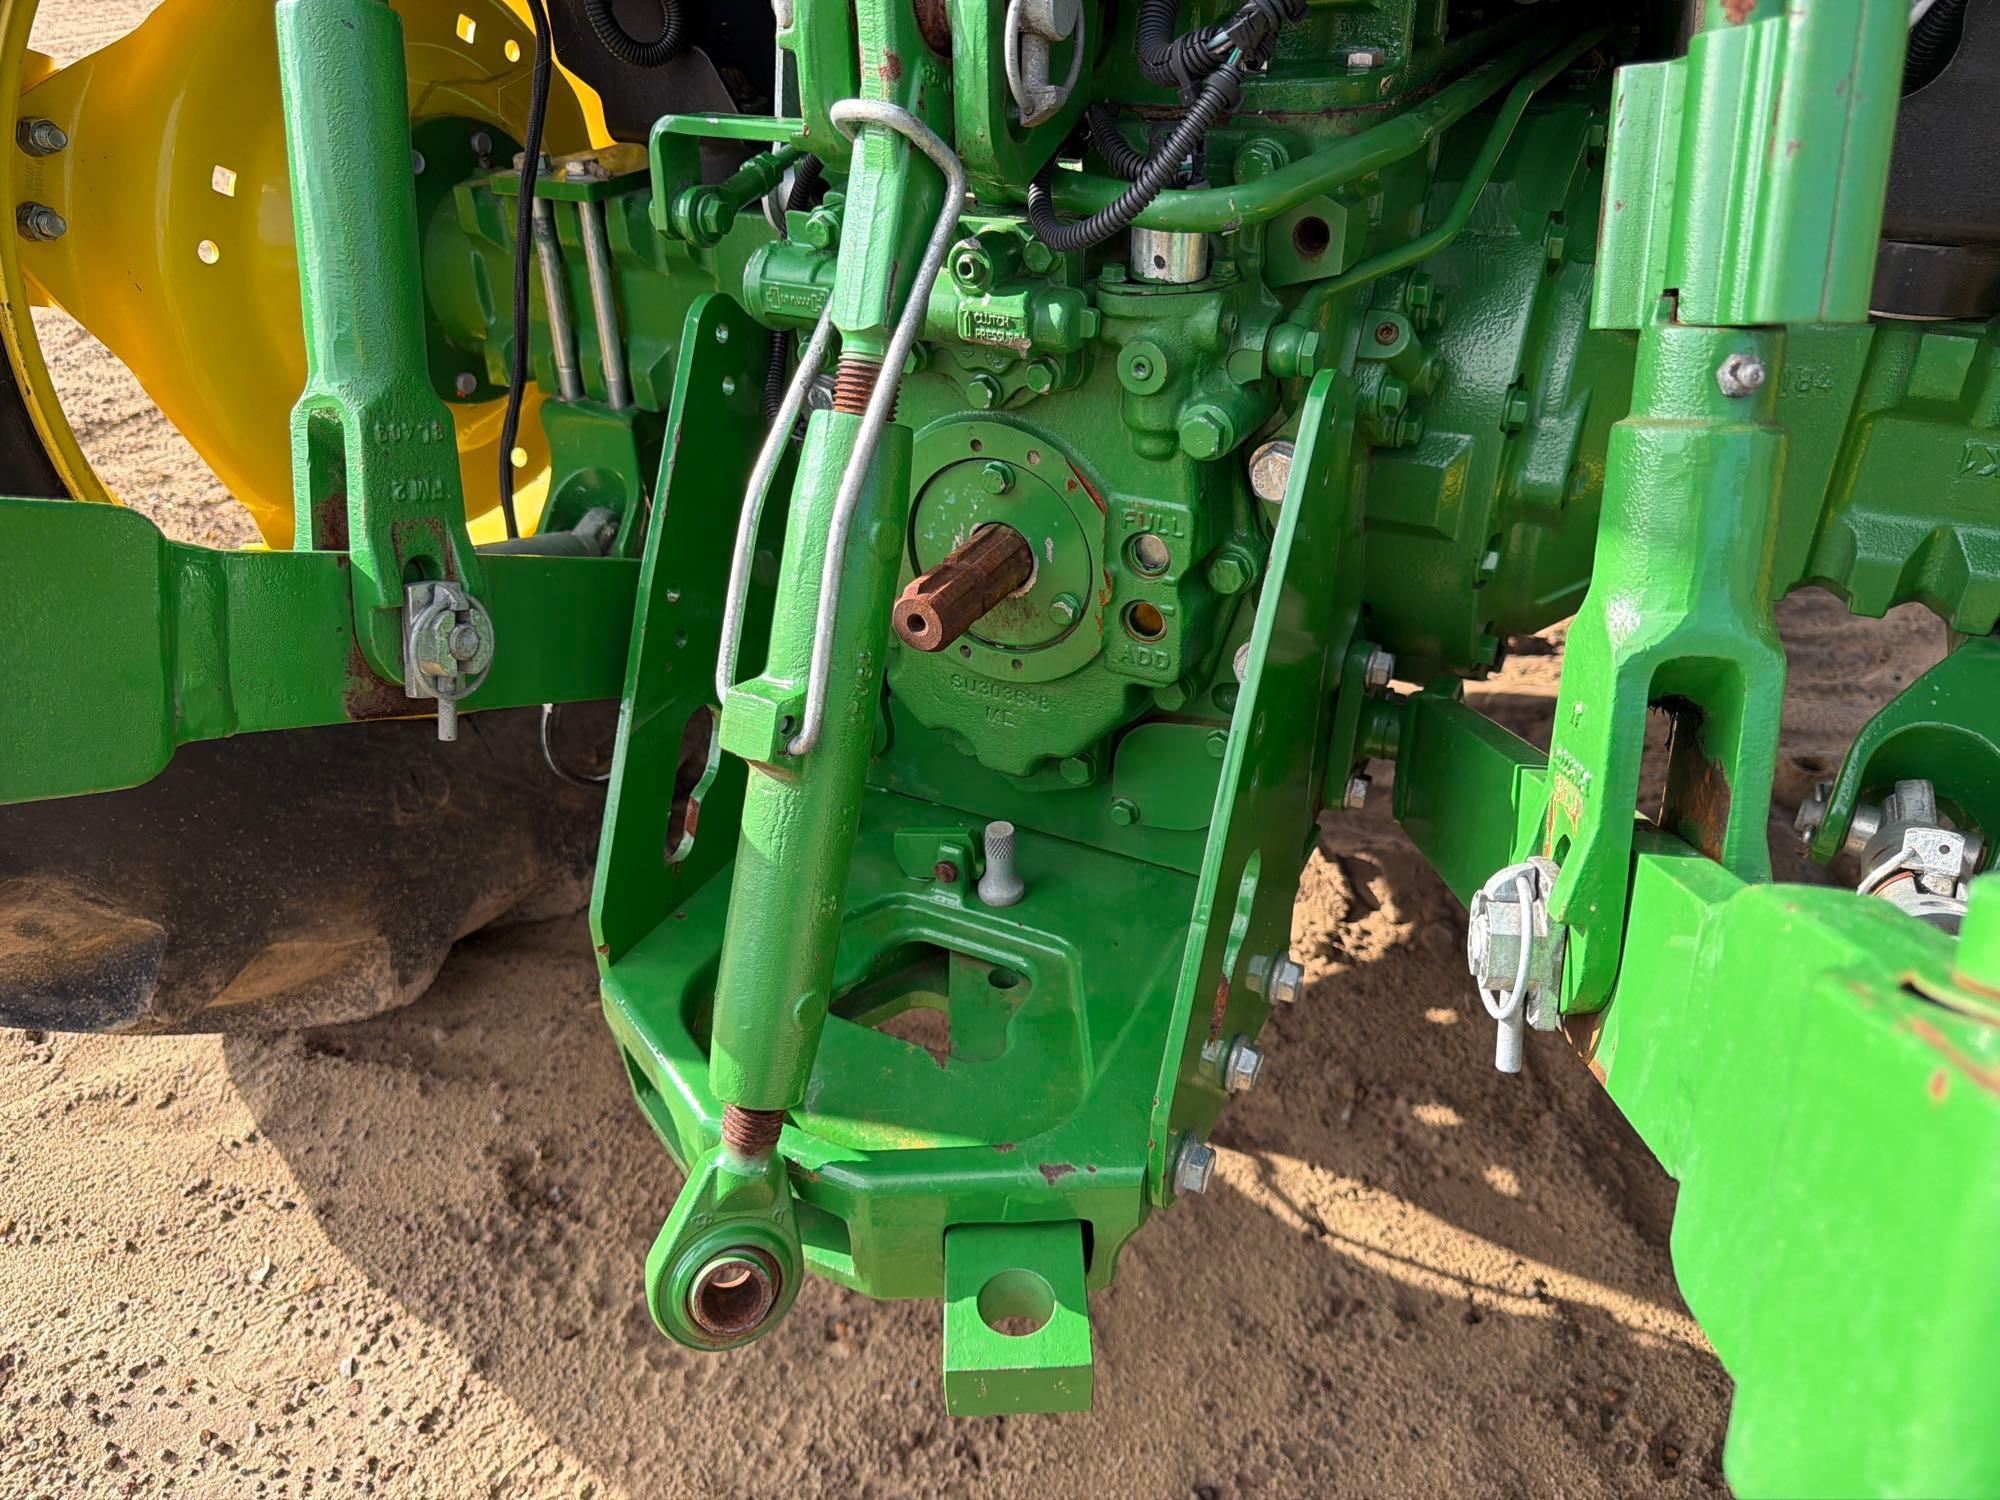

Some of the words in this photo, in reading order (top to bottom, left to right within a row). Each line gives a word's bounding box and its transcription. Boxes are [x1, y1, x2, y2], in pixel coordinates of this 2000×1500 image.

[974, 312, 1009, 327] CLUTCH
[1121, 509, 1184, 538] FULL
[1119, 645, 1171, 669] ADD
